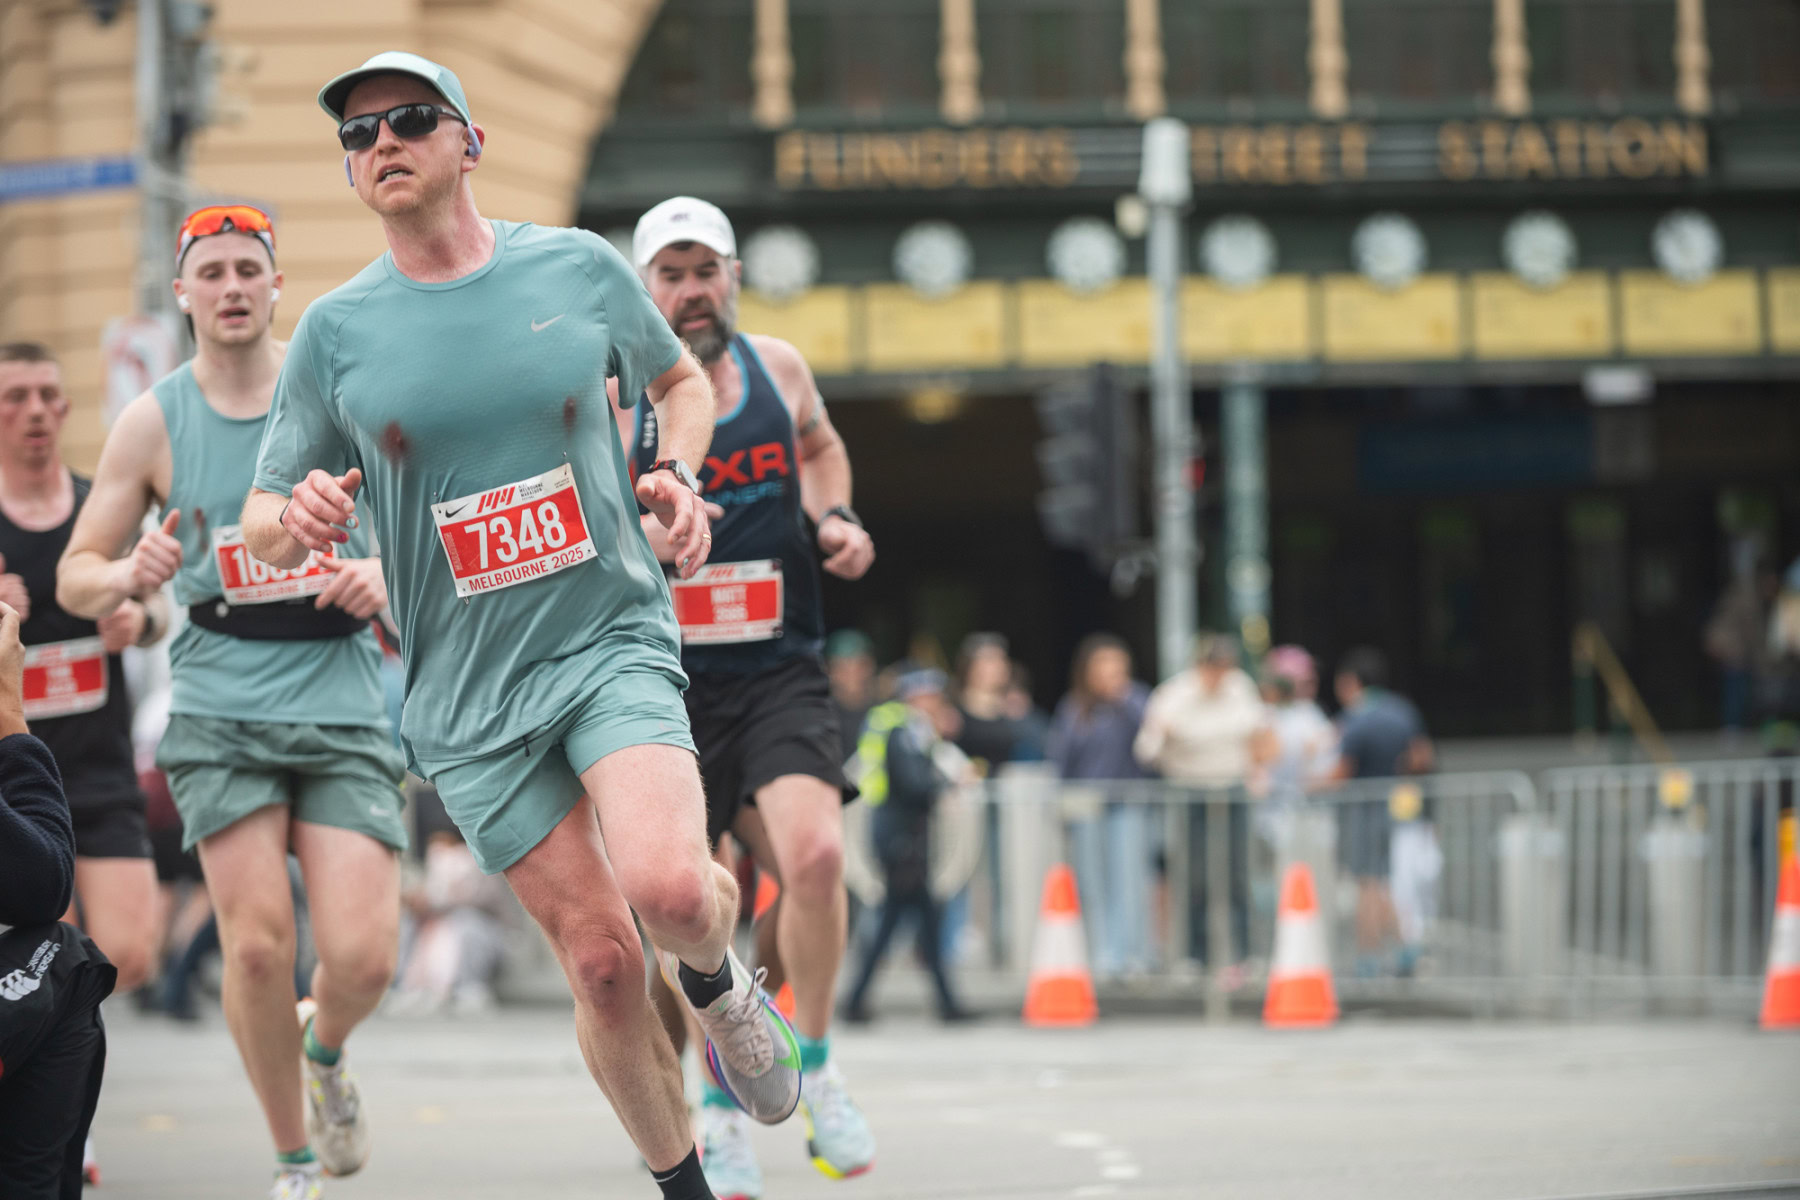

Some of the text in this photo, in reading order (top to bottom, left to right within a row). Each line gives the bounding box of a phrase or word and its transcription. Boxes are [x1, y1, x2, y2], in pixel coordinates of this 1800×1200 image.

[775, 117, 1708, 189] FLINDERS TREET STATION
[704, 441, 789, 492] XR
[464, 501, 567, 570] 7348
[469, 546, 584, 591] MELBOURNE 2025
